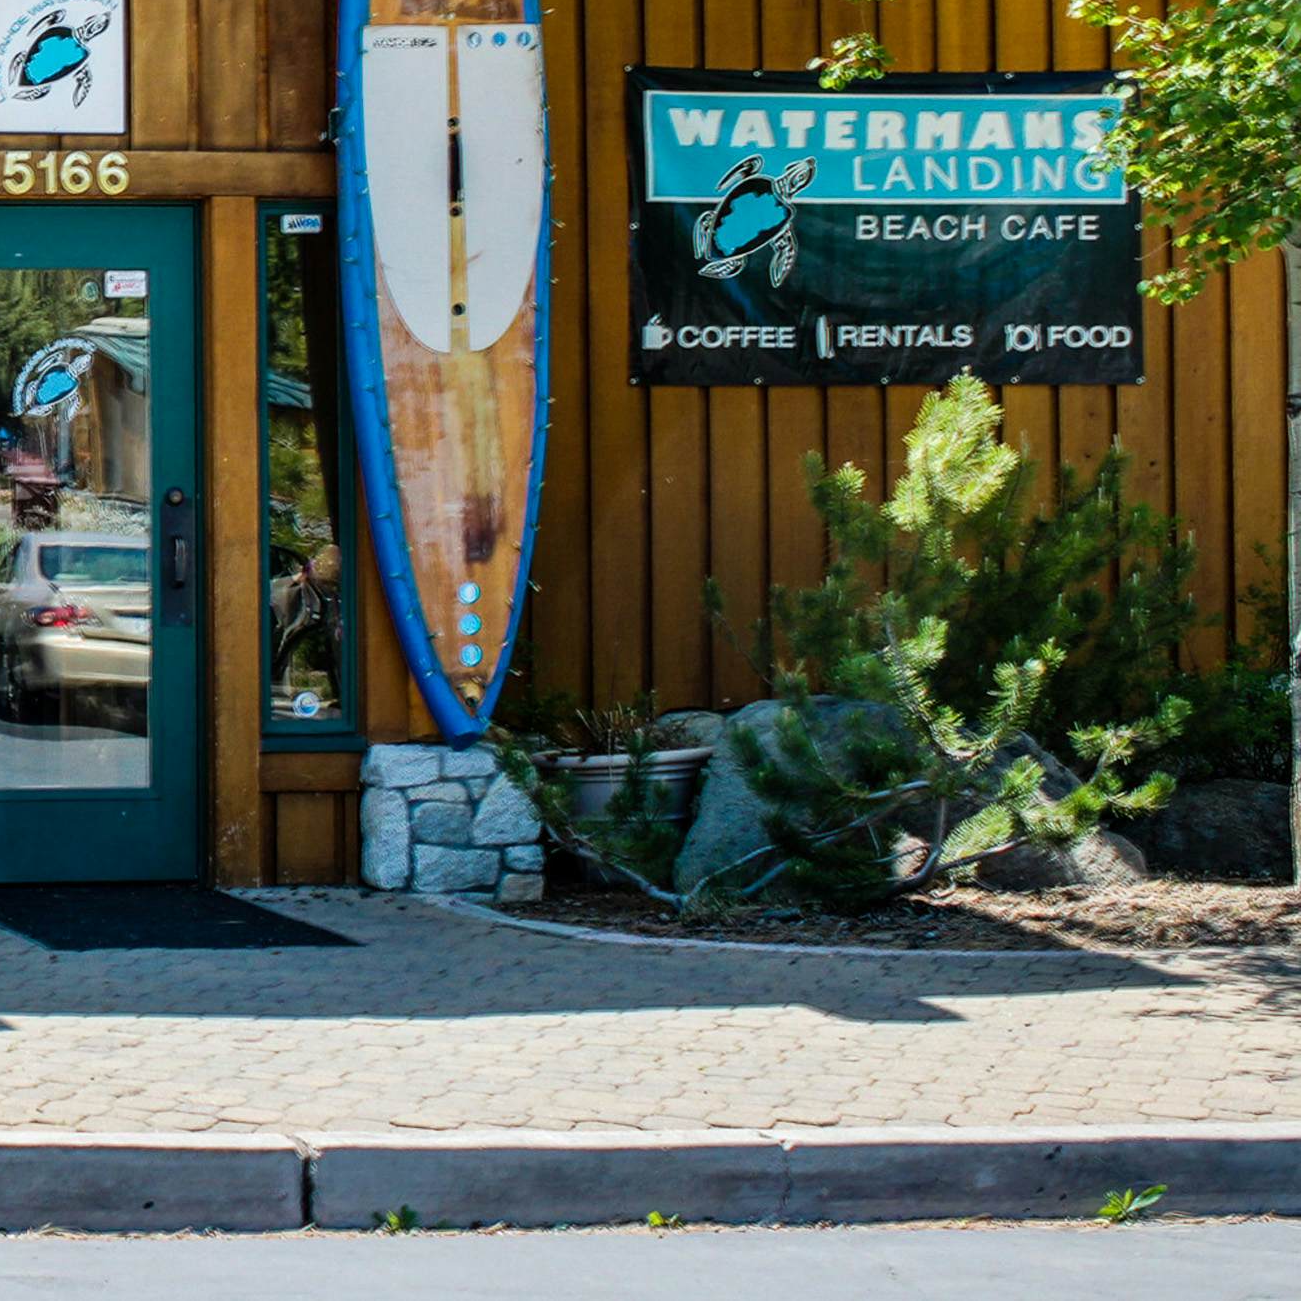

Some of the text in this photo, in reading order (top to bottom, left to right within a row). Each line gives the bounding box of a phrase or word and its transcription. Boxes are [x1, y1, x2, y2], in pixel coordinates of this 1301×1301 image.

[668, 108, 1104, 151] WATERMANS
[2, 151, 129, 195] 5166
[853, 155, 1108, 192] LANDING
[856, 215, 1100, 241] BEACH CAFE
[677, 324, 1133, 349] COFFEE RENTALS FOOD
